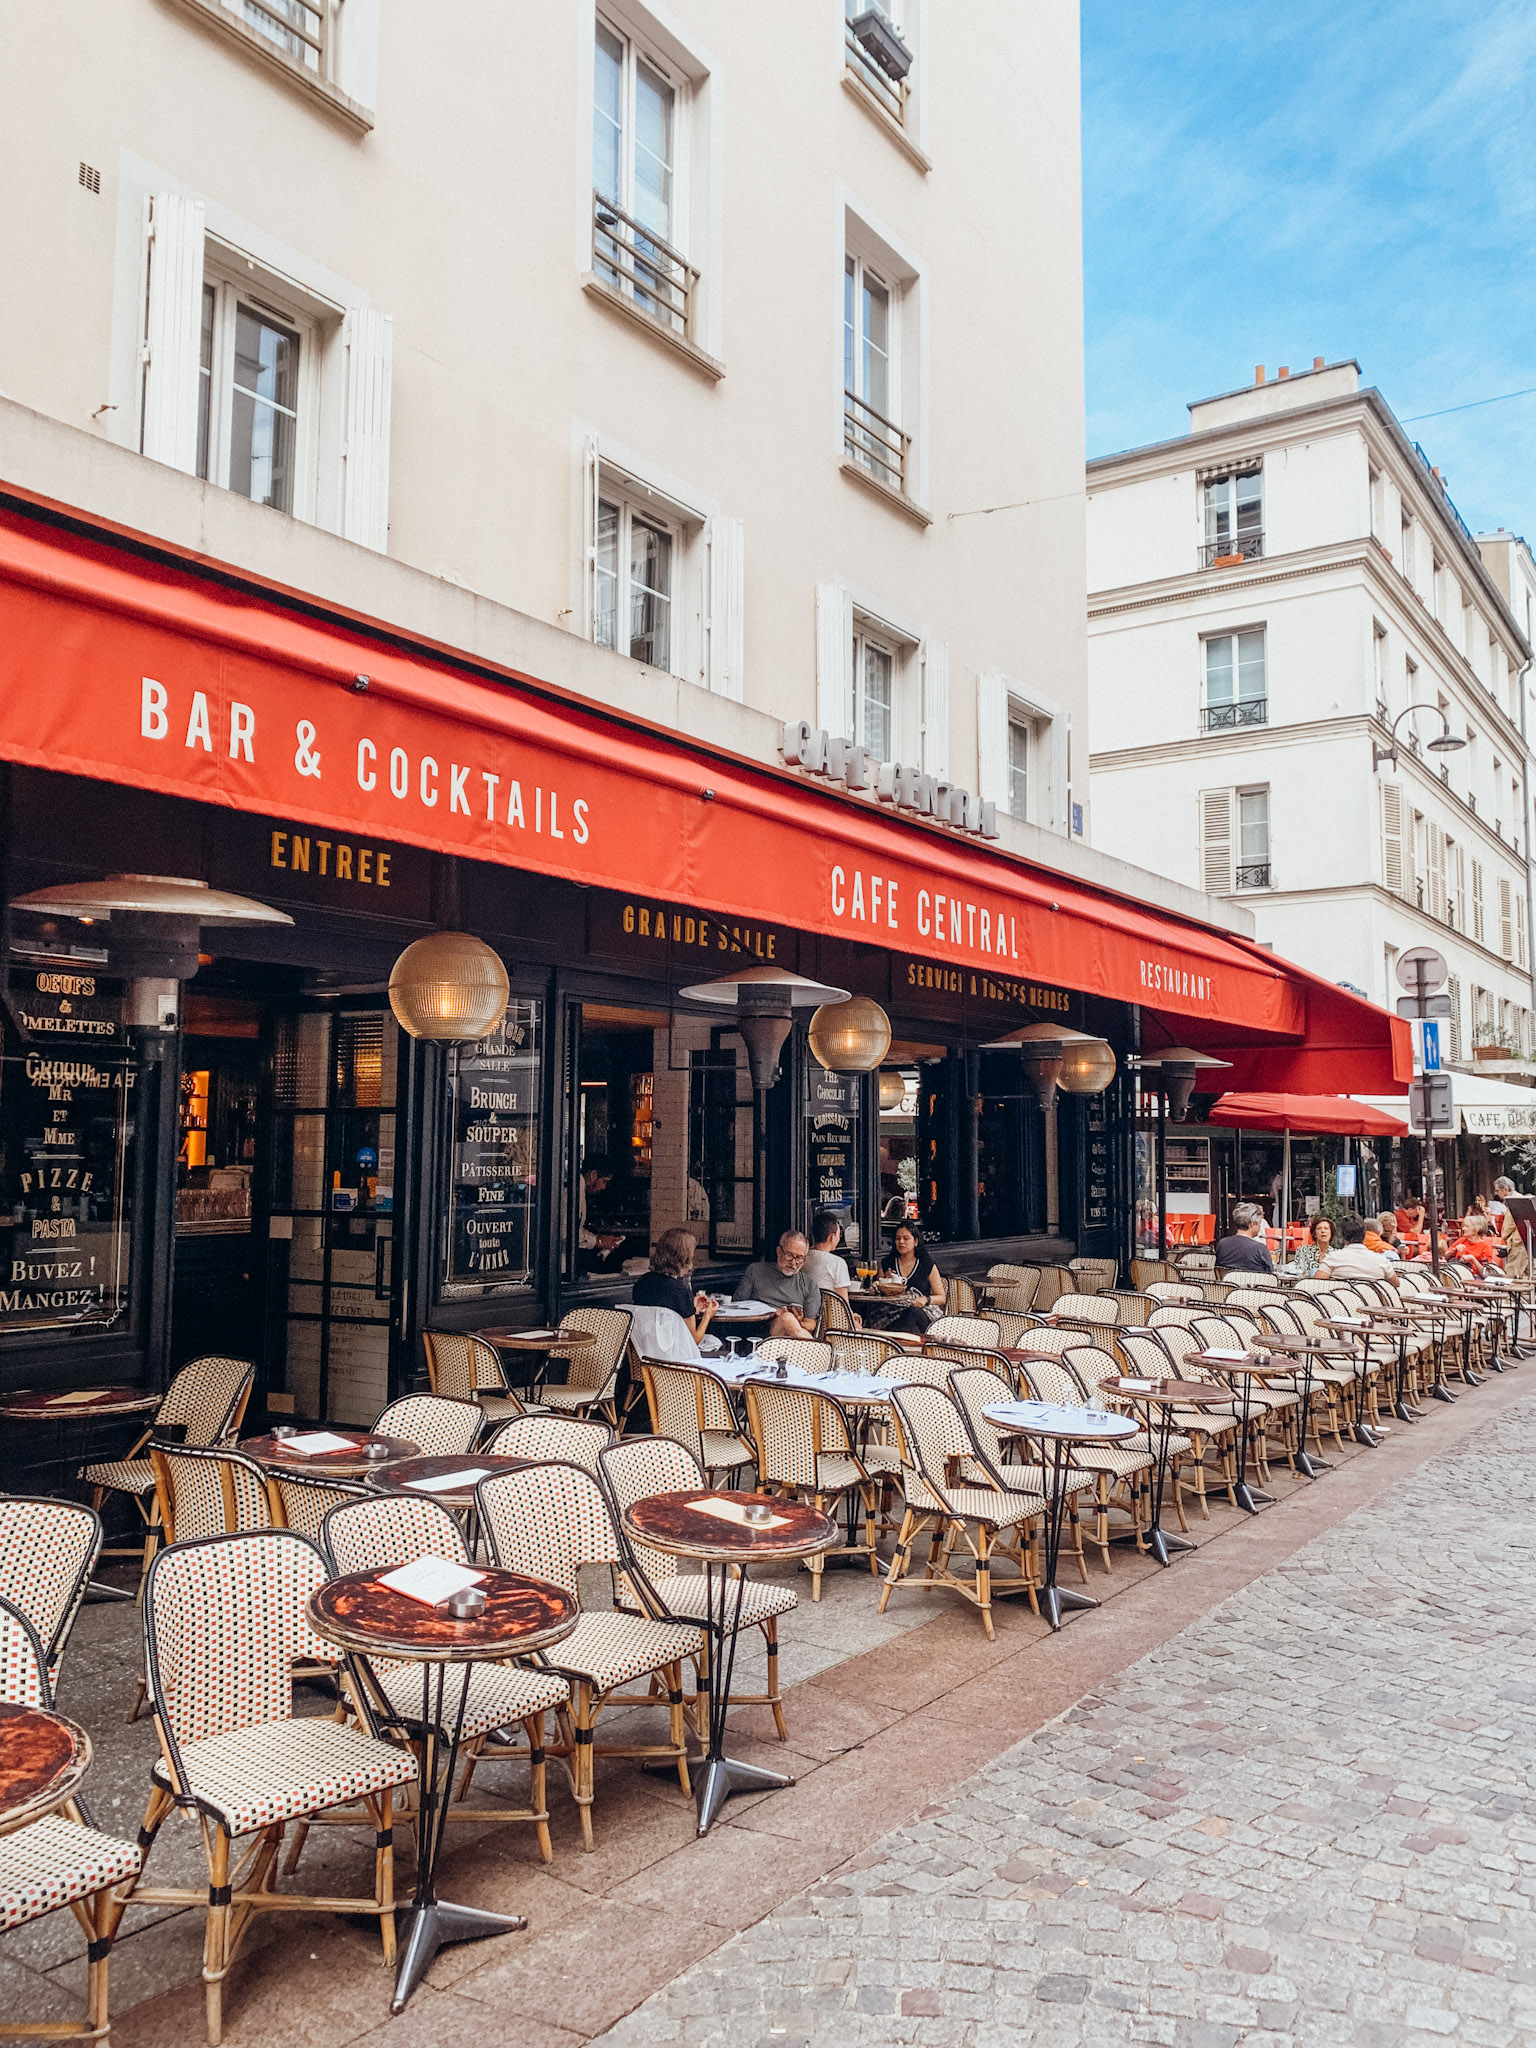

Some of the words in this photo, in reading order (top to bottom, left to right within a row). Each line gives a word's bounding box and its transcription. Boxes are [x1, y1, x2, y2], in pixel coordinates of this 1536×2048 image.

[141, 677, 255, 763] BAR
[295, 719, 321, 779] &
[357, 738, 590, 845] COCKTAILS
[783, 720, 871, 791] CAFE
[878, 762, 1000, 840] CENTRAL
[271, 831, 391, 887] ENTREE
[831, 865, 899, 929] CAFE
[917, 889, 1019, 959] CENTRAL
[622, 905, 708, 947] GRANDE
[36, 972, 96, 996] OEUFS
[1140, 960, 1211, 1001] RESTAURANT
[59, 1000, 72, 1013] &
[1029, 986, 1069, 1012] HEURES
[475, 1042, 515, 1056] GRANDE
[480, 1060, 510, 1072] SALLE
[470, 1086, 517, 1109] BRUNCH
[53, 1110, 68, 1122] ET
[489, 1112, 497, 1124] &
[466, 1126, 517, 1143] SOUPER
[812, 1132, 826, 1143] PAIN
[461, 1162, 522, 1177] PÂTISSERIE
[829, 1167, 834, 1176] &
[820, 1175, 842, 1188] SODAS
[478, 1187, 504, 1202] FINE
[819, 1189, 843, 1202] FRAIS
[51, 1196, 61, 1211] &
[32, 1218, 76, 1238] PASTA
[466, 1219, 513, 1234] OUVERT
[479, 1236, 500, 1248] toute
